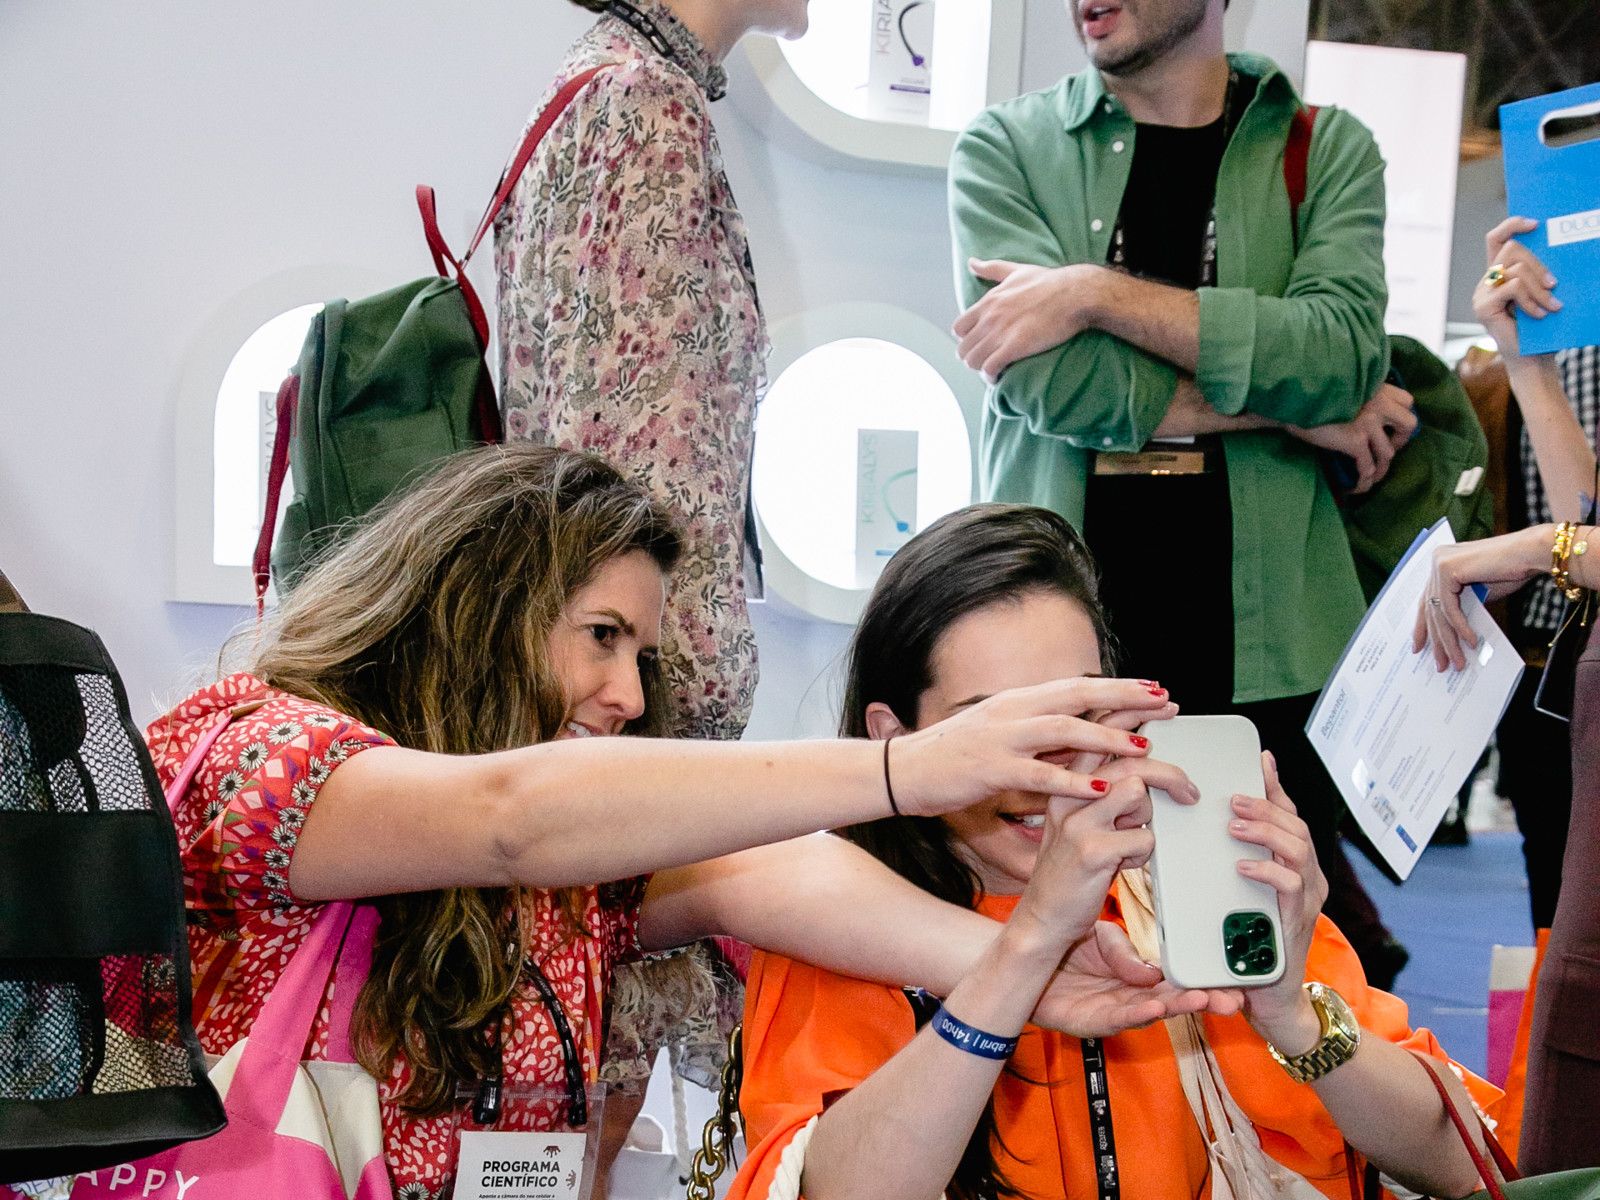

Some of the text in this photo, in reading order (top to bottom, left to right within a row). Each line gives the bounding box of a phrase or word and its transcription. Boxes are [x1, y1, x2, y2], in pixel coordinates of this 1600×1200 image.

[942, 1018, 970, 1043] 14h00
[980, 1038, 1007, 1053] abril
[482, 1160, 560, 1173] PROGRAMA
[481, 1173, 558, 1188] CIENTÍFICO
